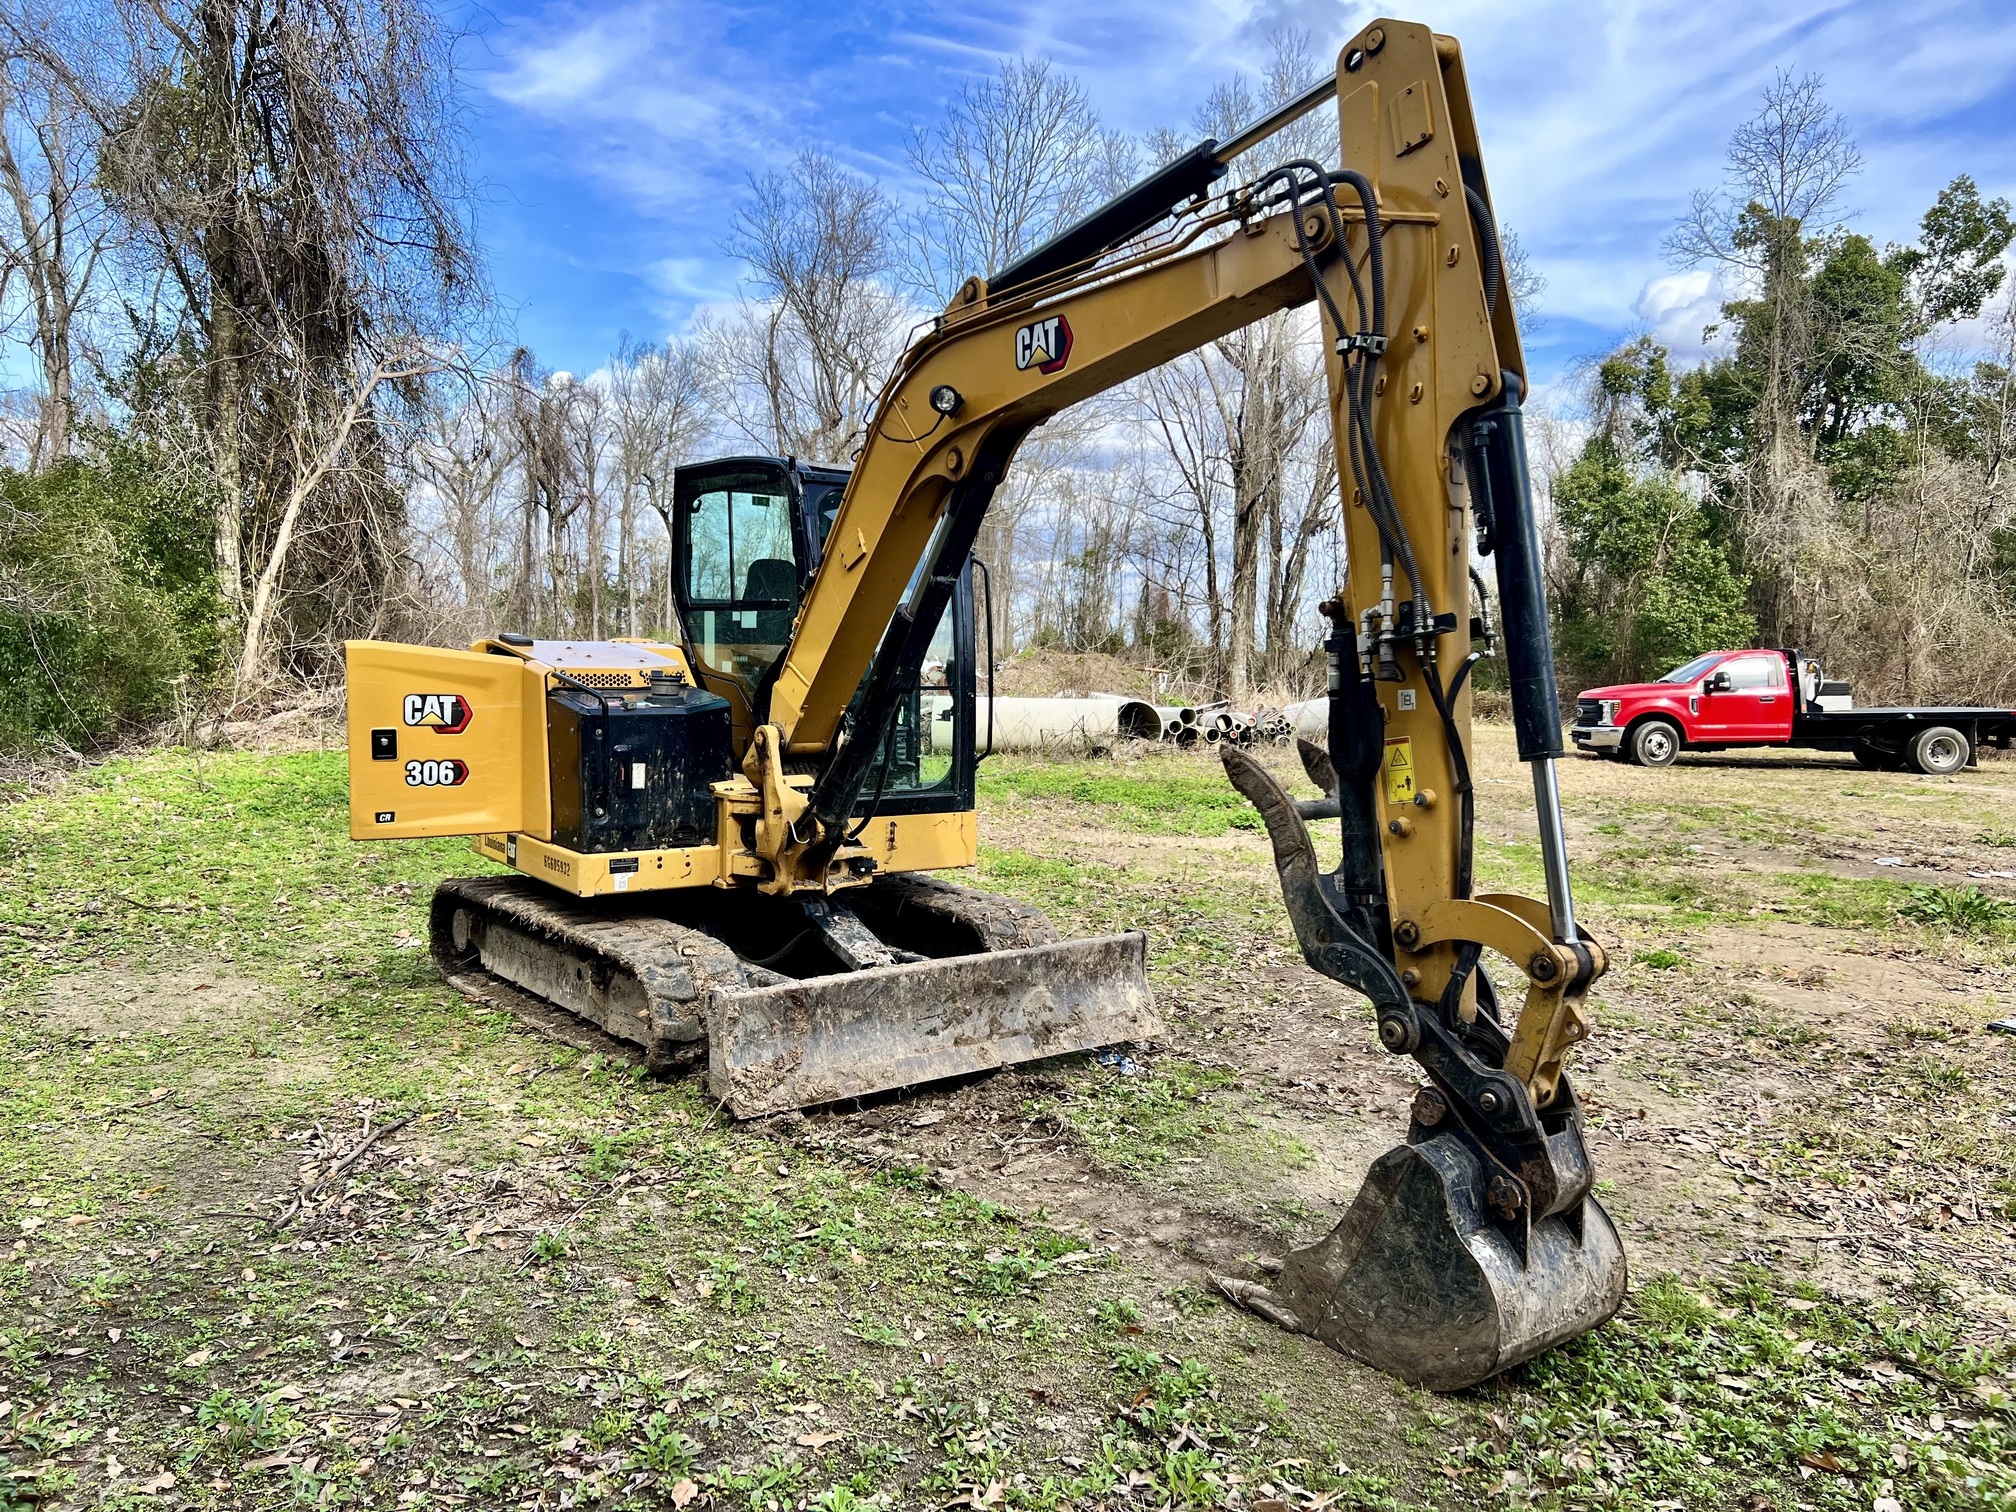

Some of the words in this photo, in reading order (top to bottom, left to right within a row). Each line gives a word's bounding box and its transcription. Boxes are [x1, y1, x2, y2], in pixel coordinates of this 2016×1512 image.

[1016, 316, 1059, 369] CAT
[404, 694, 457, 726] CAT
[405, 760, 455, 786] 306
[379, 813, 392, 822] CR
